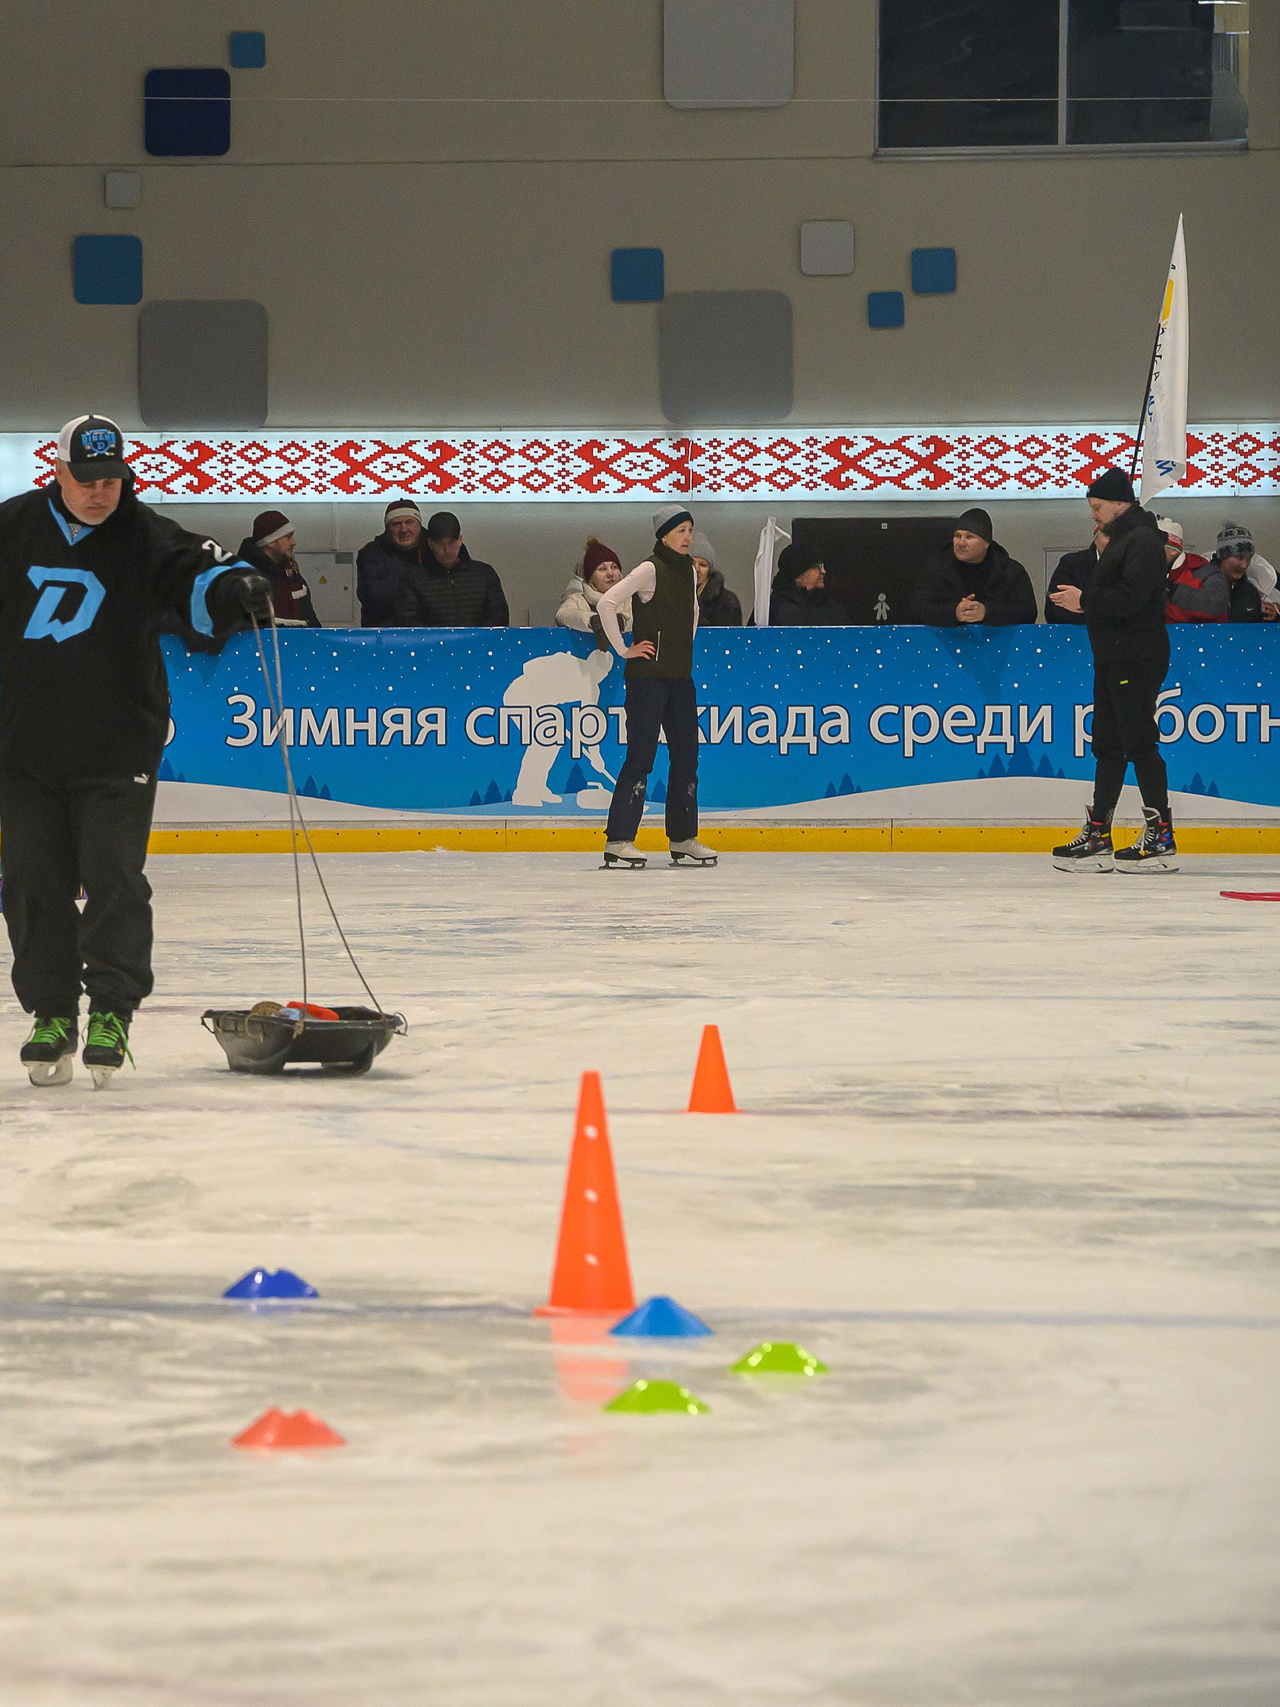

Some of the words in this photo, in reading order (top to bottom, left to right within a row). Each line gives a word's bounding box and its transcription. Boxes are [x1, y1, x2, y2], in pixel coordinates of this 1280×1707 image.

[225, 693, 448, 748] Зимняя
[464, 703, 851, 759] спартиада
[868, 703, 1054, 758] среди
[1073, 687, 1280, 758] рботн
